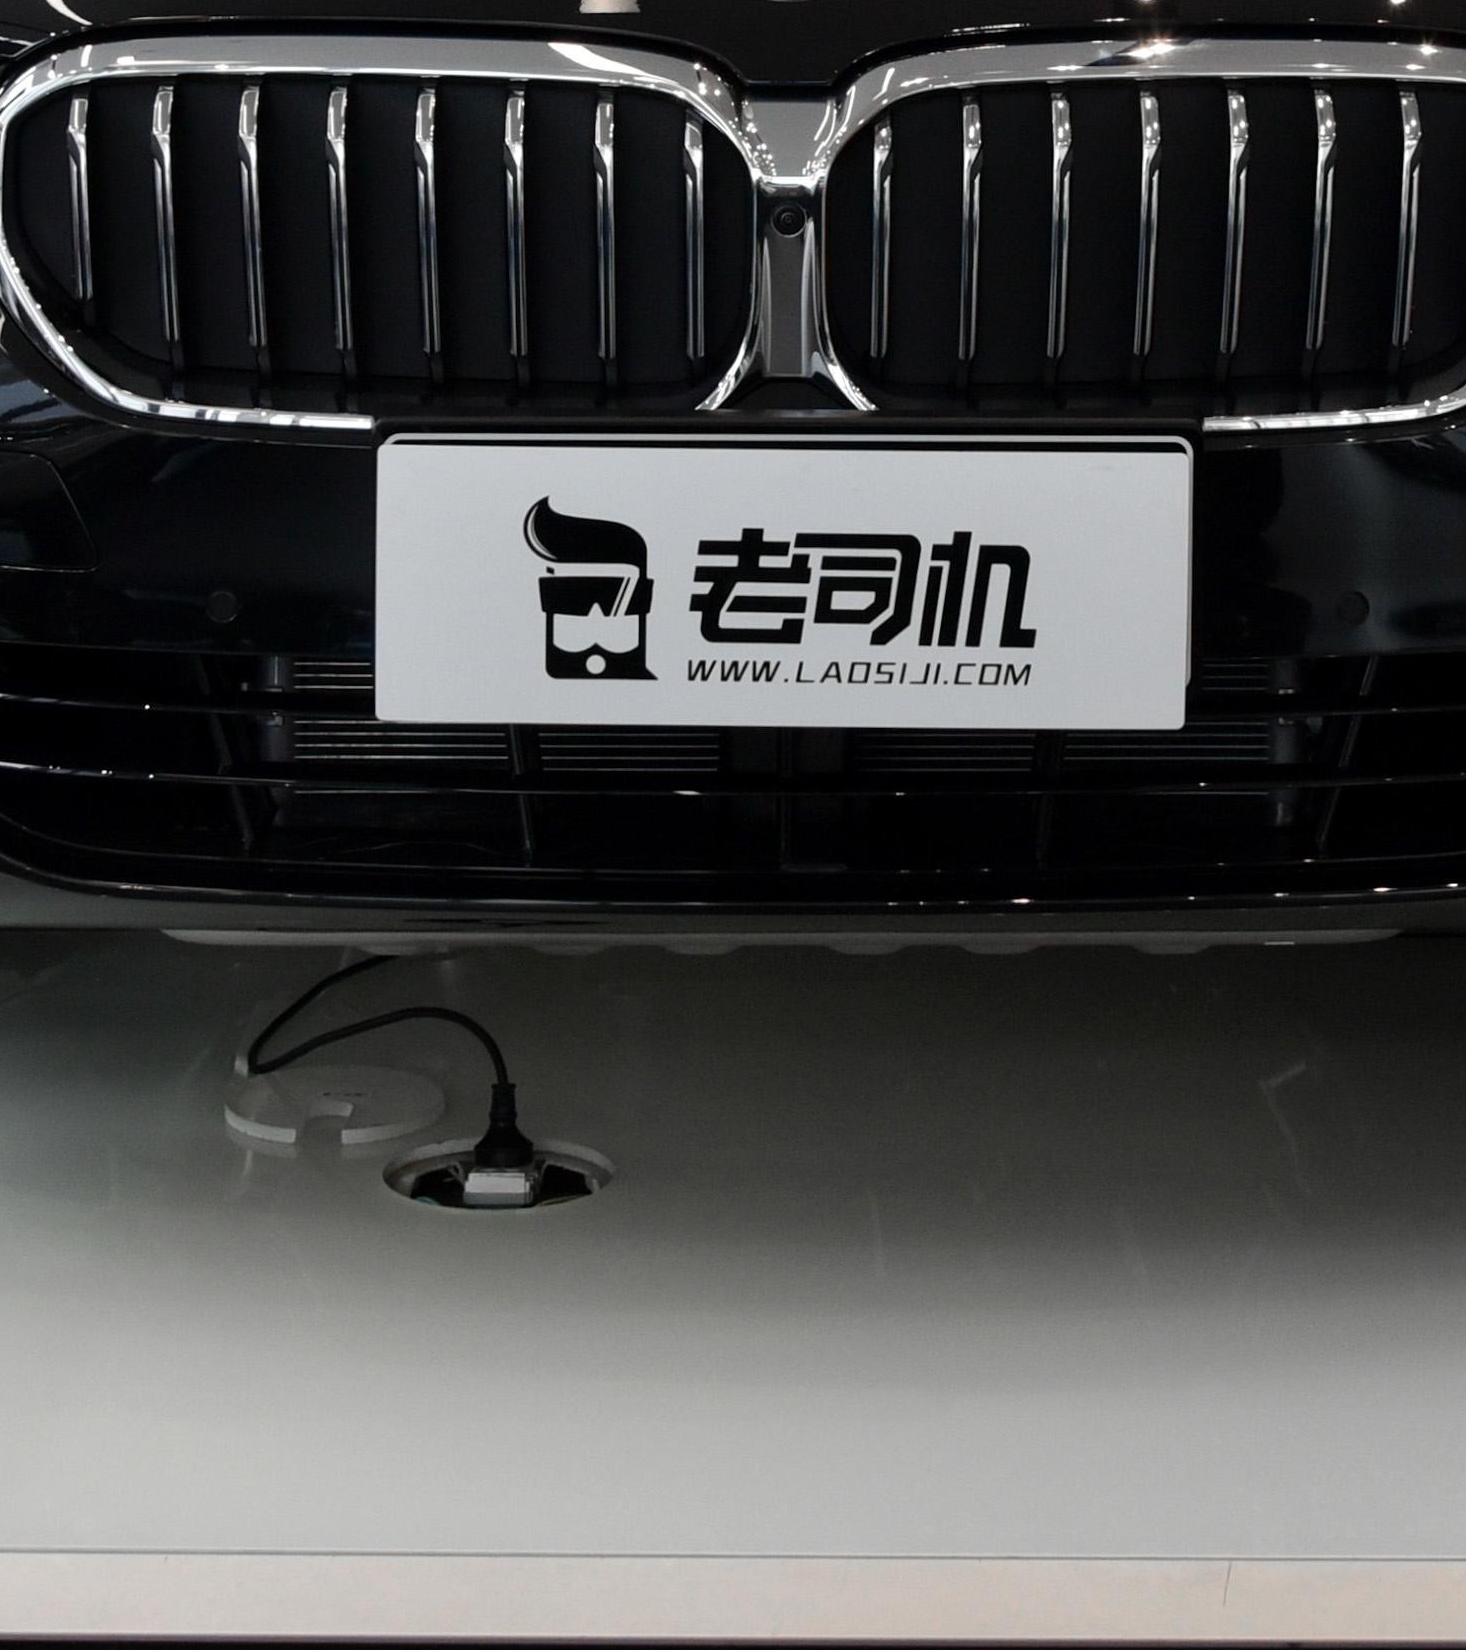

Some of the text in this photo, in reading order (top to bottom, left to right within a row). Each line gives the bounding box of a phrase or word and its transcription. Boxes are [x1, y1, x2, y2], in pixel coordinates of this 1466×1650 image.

[688, 527, 1037, 649] 老司机
[687, 659, 1032, 686] WWW.LAOSIJI.COM
